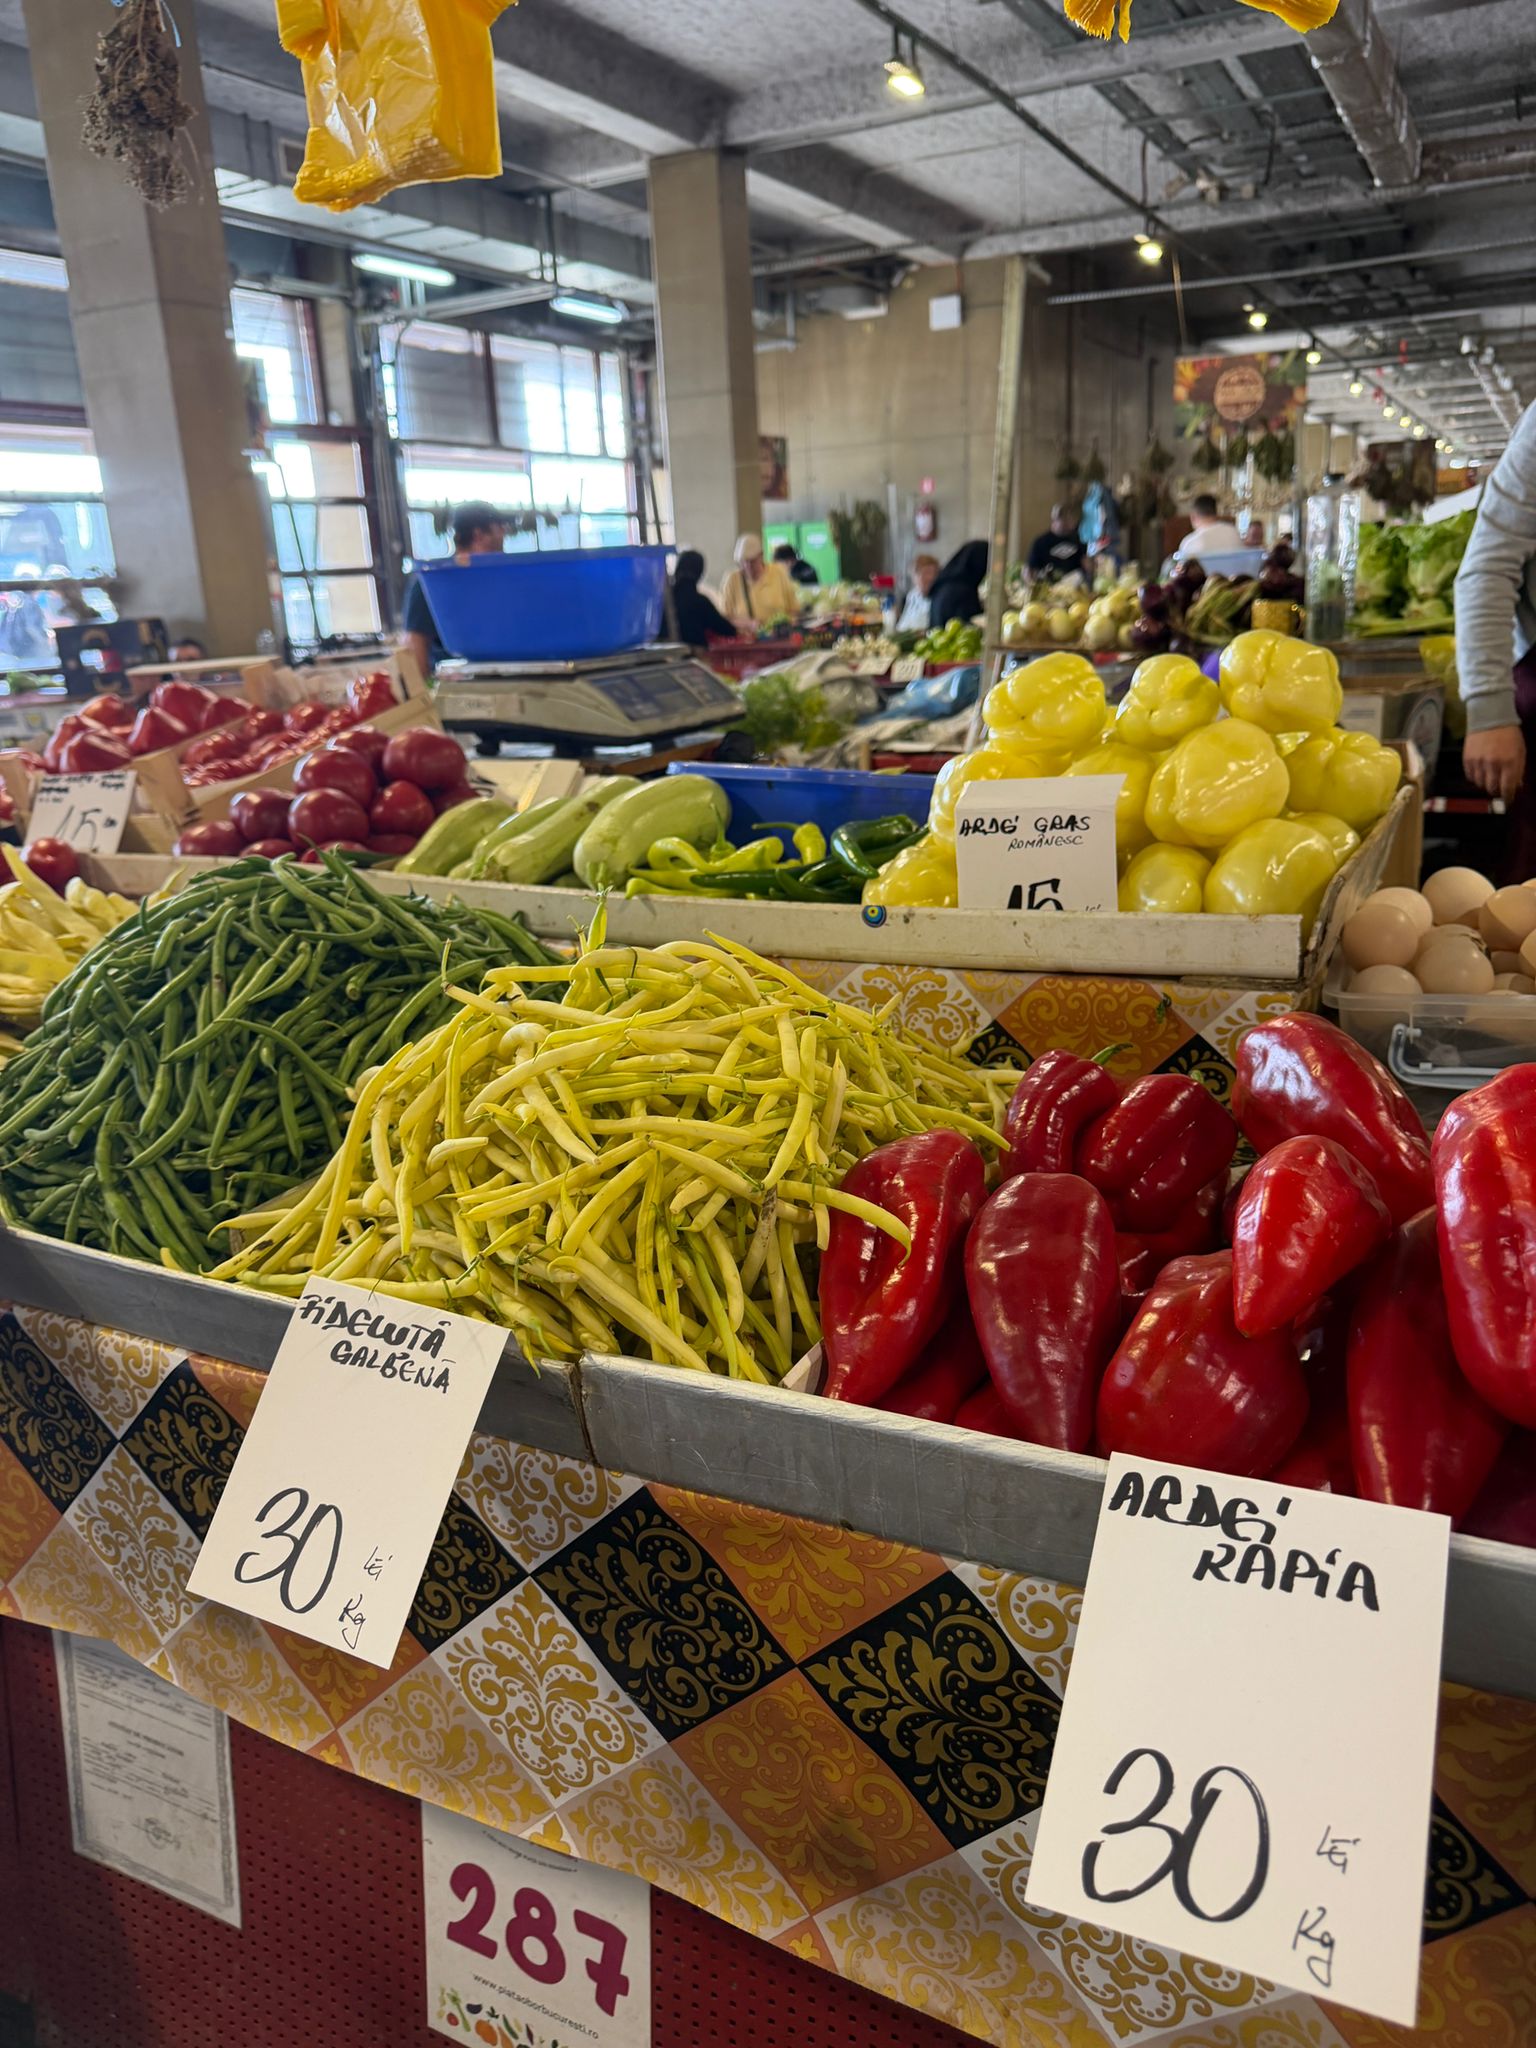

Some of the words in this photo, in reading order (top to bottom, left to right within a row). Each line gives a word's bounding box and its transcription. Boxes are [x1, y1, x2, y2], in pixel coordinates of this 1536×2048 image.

[234, 1487, 342, 1613] 30
[1081, 1748, 1270, 1922] 30
[446, 1862, 630, 2018] 287
